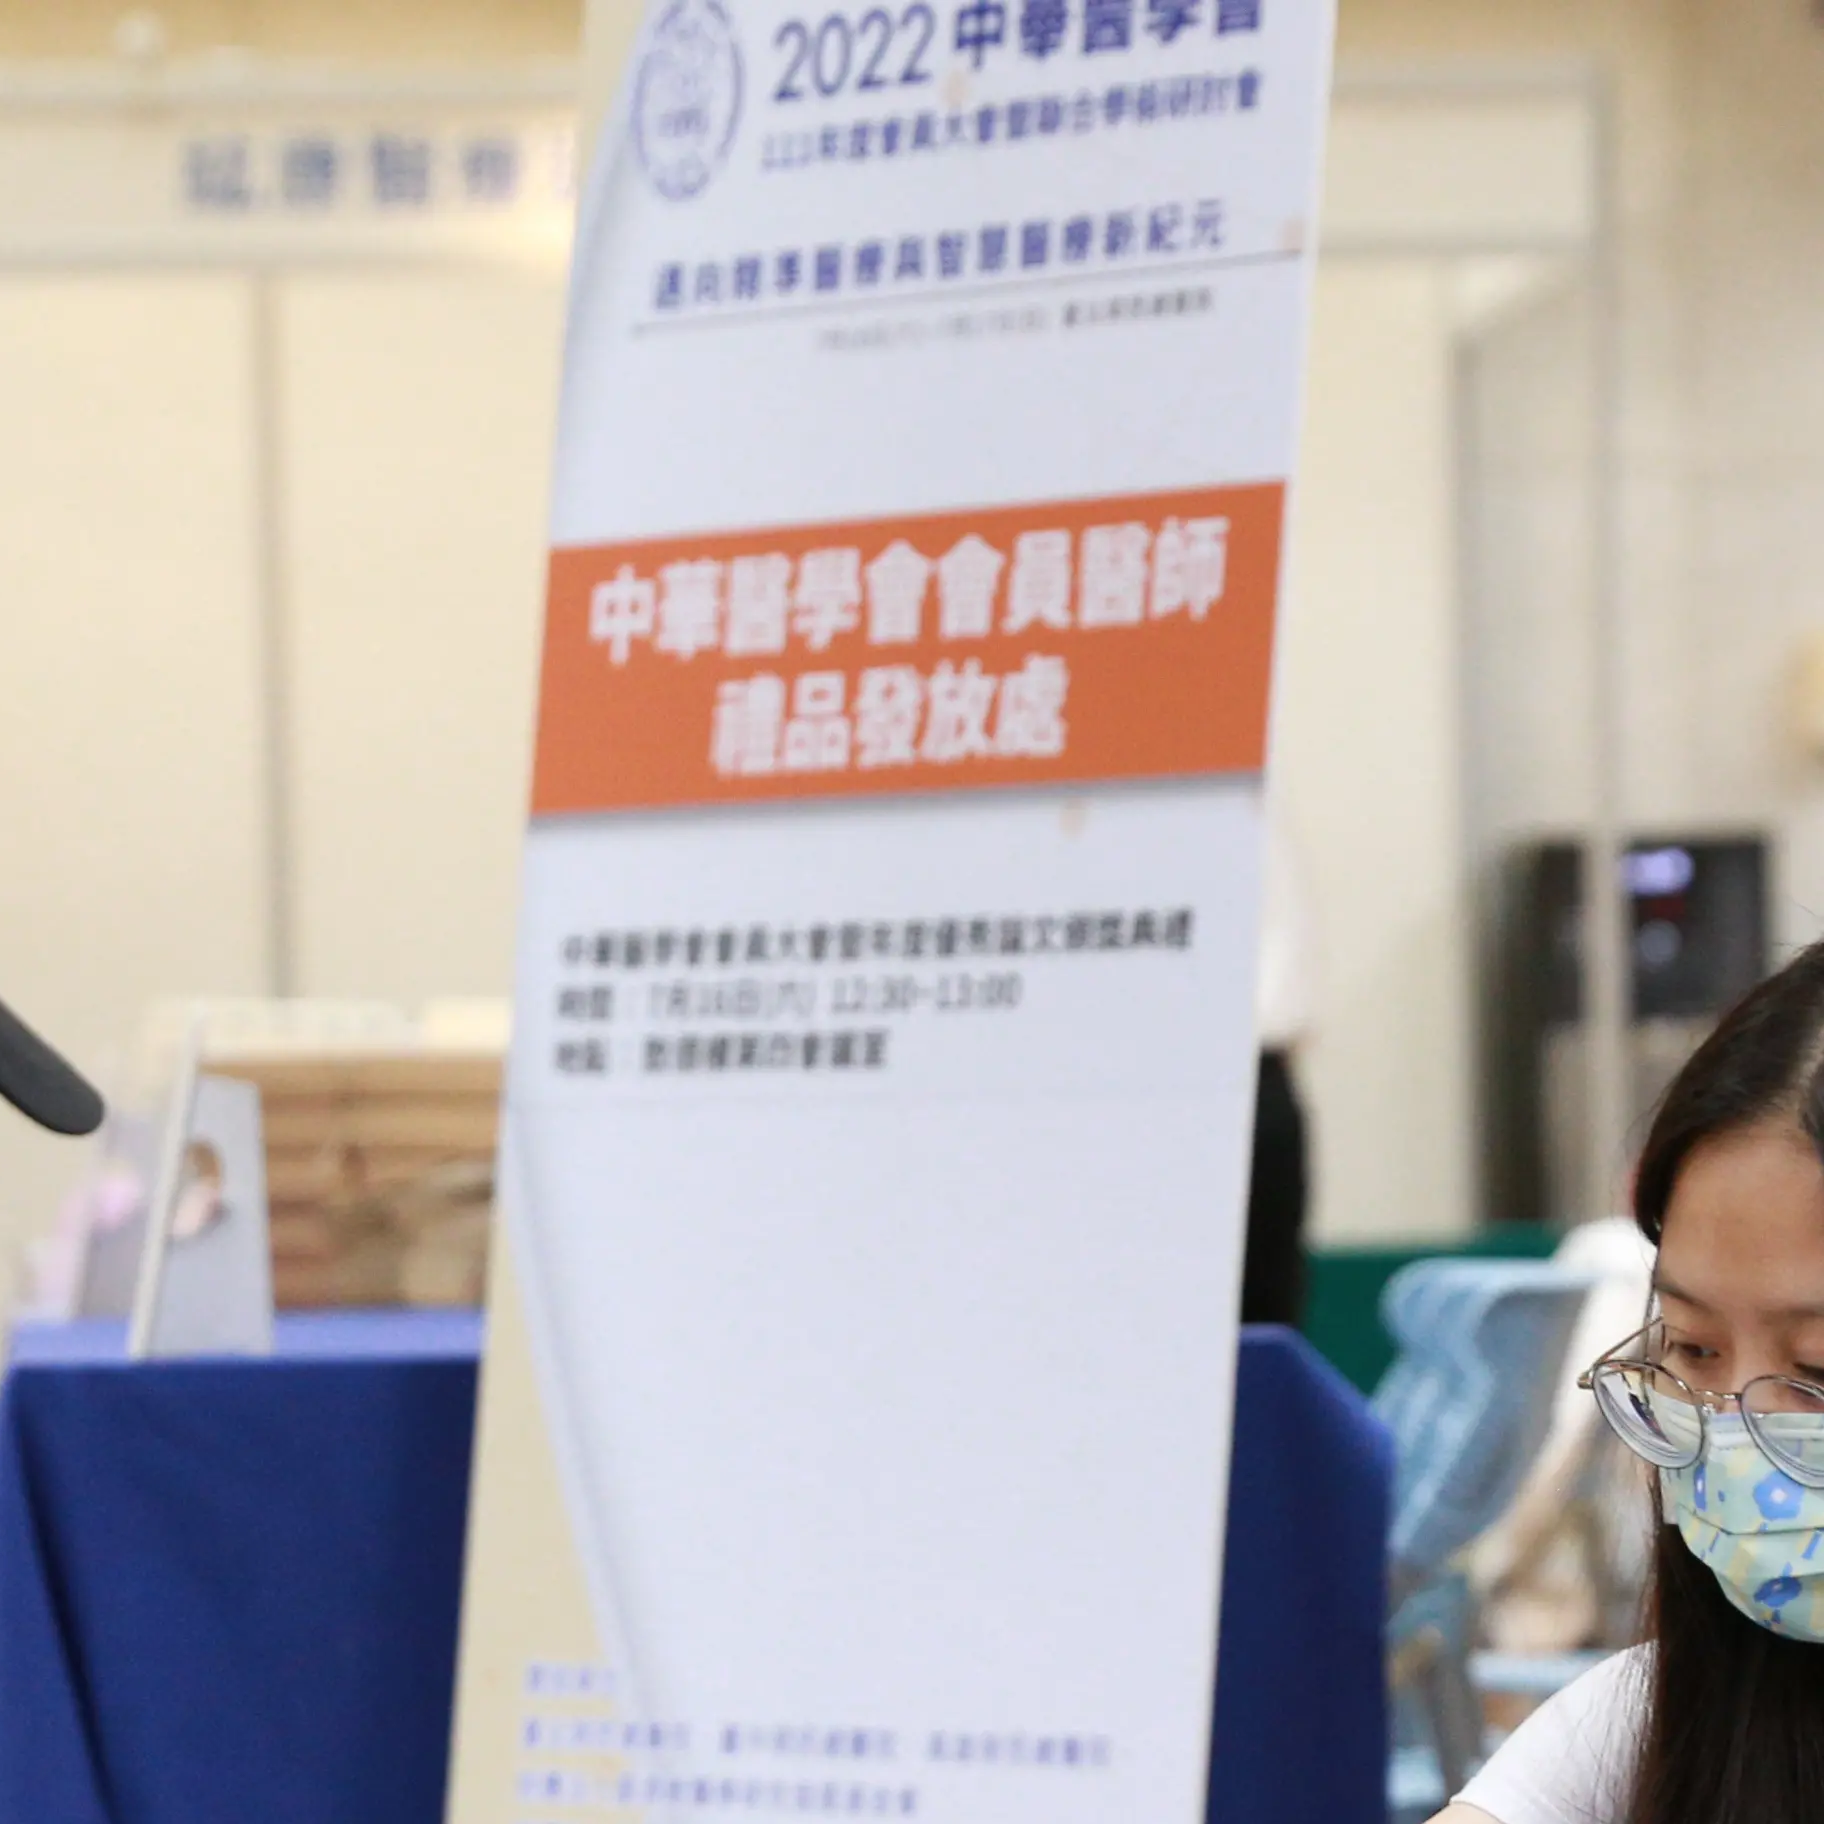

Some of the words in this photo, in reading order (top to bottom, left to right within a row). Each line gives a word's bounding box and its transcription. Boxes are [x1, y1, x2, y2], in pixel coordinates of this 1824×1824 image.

[773, 3, 936, 102] 2022
[588, 516, 1231, 667] 中華醫學會會員醫師
[711, 655, 1070, 780] 禮品發放處
